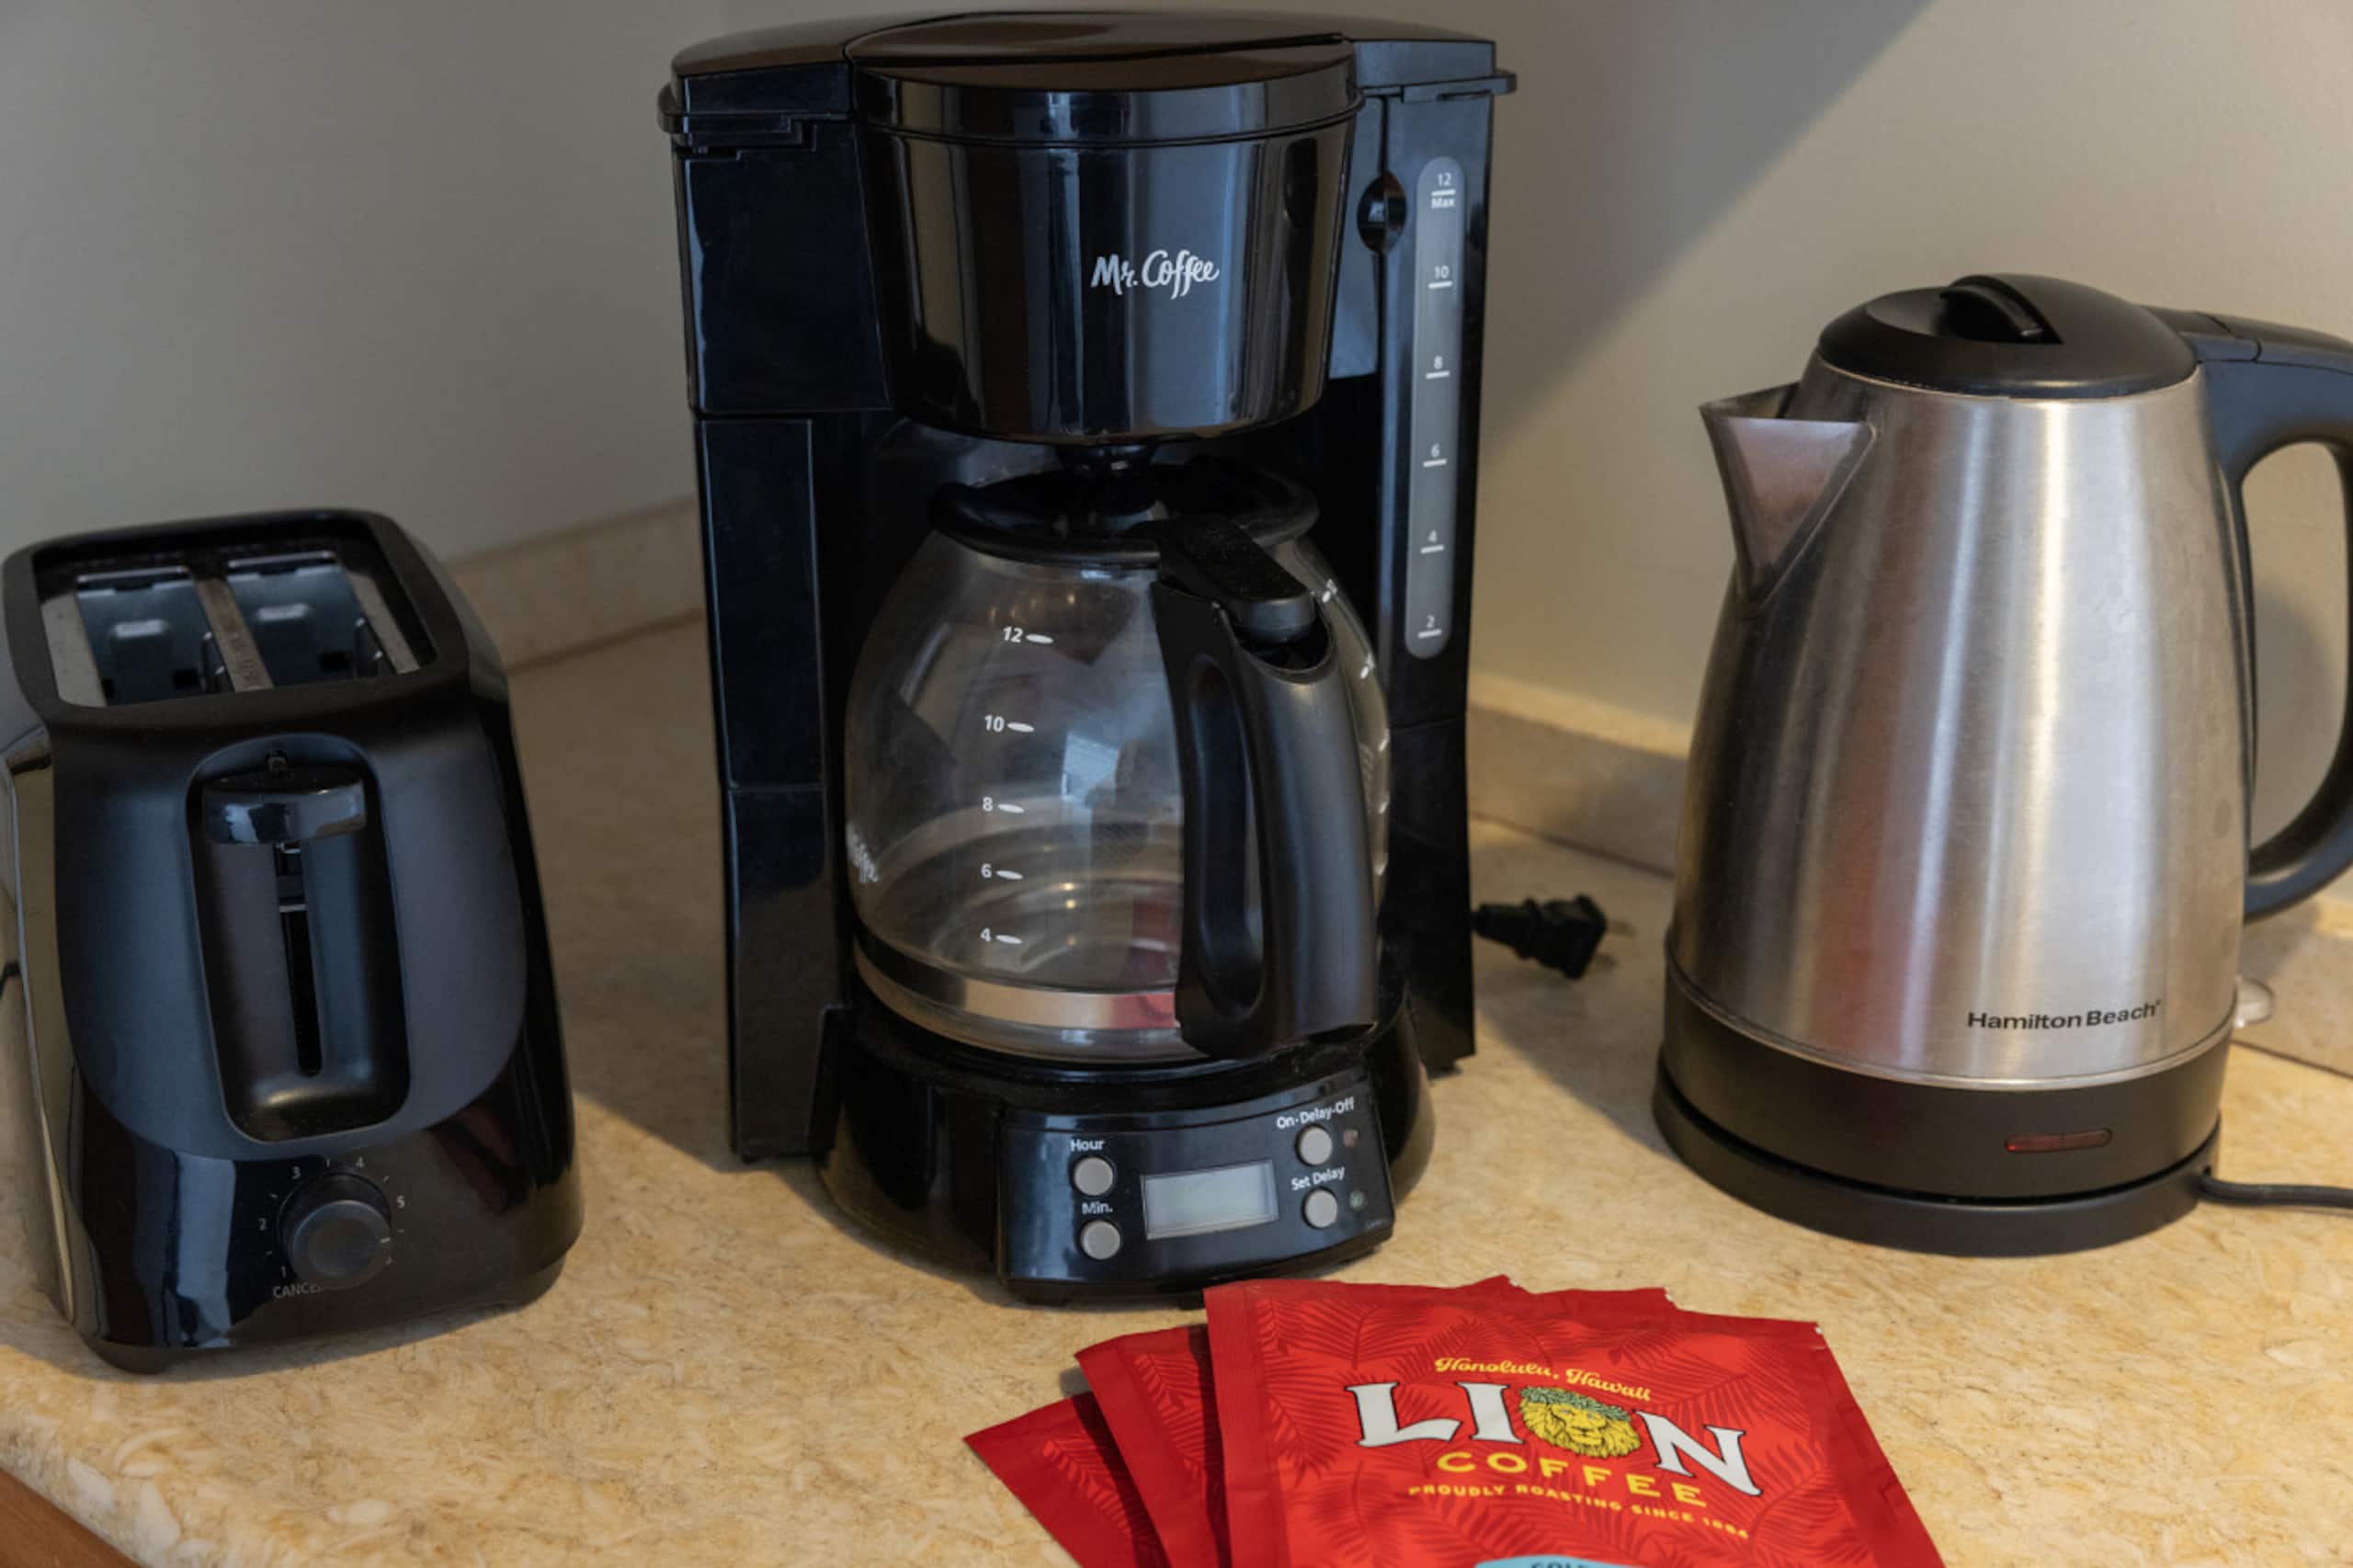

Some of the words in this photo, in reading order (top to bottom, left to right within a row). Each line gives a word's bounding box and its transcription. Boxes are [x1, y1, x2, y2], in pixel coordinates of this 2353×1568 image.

[1437, 173, 1452, 186] 12
[1431, 198, 1455, 210] Max
[1091, 253, 1139, 295] Mr.
[1142, 249, 1220, 300] Coffee
[1434, 266, 1449, 278] 10
[1434, 356, 1443, 369] 8
[1430, 443, 1440, 458] 6
[1427, 529, 1438, 542] 4
[1426, 615, 1436, 628] 2
[1003, 626, 1023, 643] 12
[984, 714, 1005, 733] 10
[983, 796, 994, 812] 8
[981, 863, 993, 879] 6
[980, 927, 992, 942] 4
[1968, 1012, 2082, 1029] Hamilton
[2086, 1002, 2156, 1027] Beach
[1071, 1139, 1106, 1152] Hour
[356, 1156, 364, 1168] 4
[292, 1166, 301, 1178] 3
[1291, 1176, 1311, 1190] Set
[1312, 1166, 1346, 1185] Delay
[396, 1196, 405, 1208] 5
[1082, 1201, 1113, 1214] Min.
[257, 1218, 267, 1231] 2
[1435, 1357, 1559, 1380] Honolulu,
[1565, 1368, 1651, 1402] Hawaii
[1437, 1451, 1707, 1507] COFFEE
[1408, 1484, 1505, 1497] PROUDLY
[1516, 1483, 1622, 1511] ROASTING
[1631, 1504, 1694, 1523] SINCE
